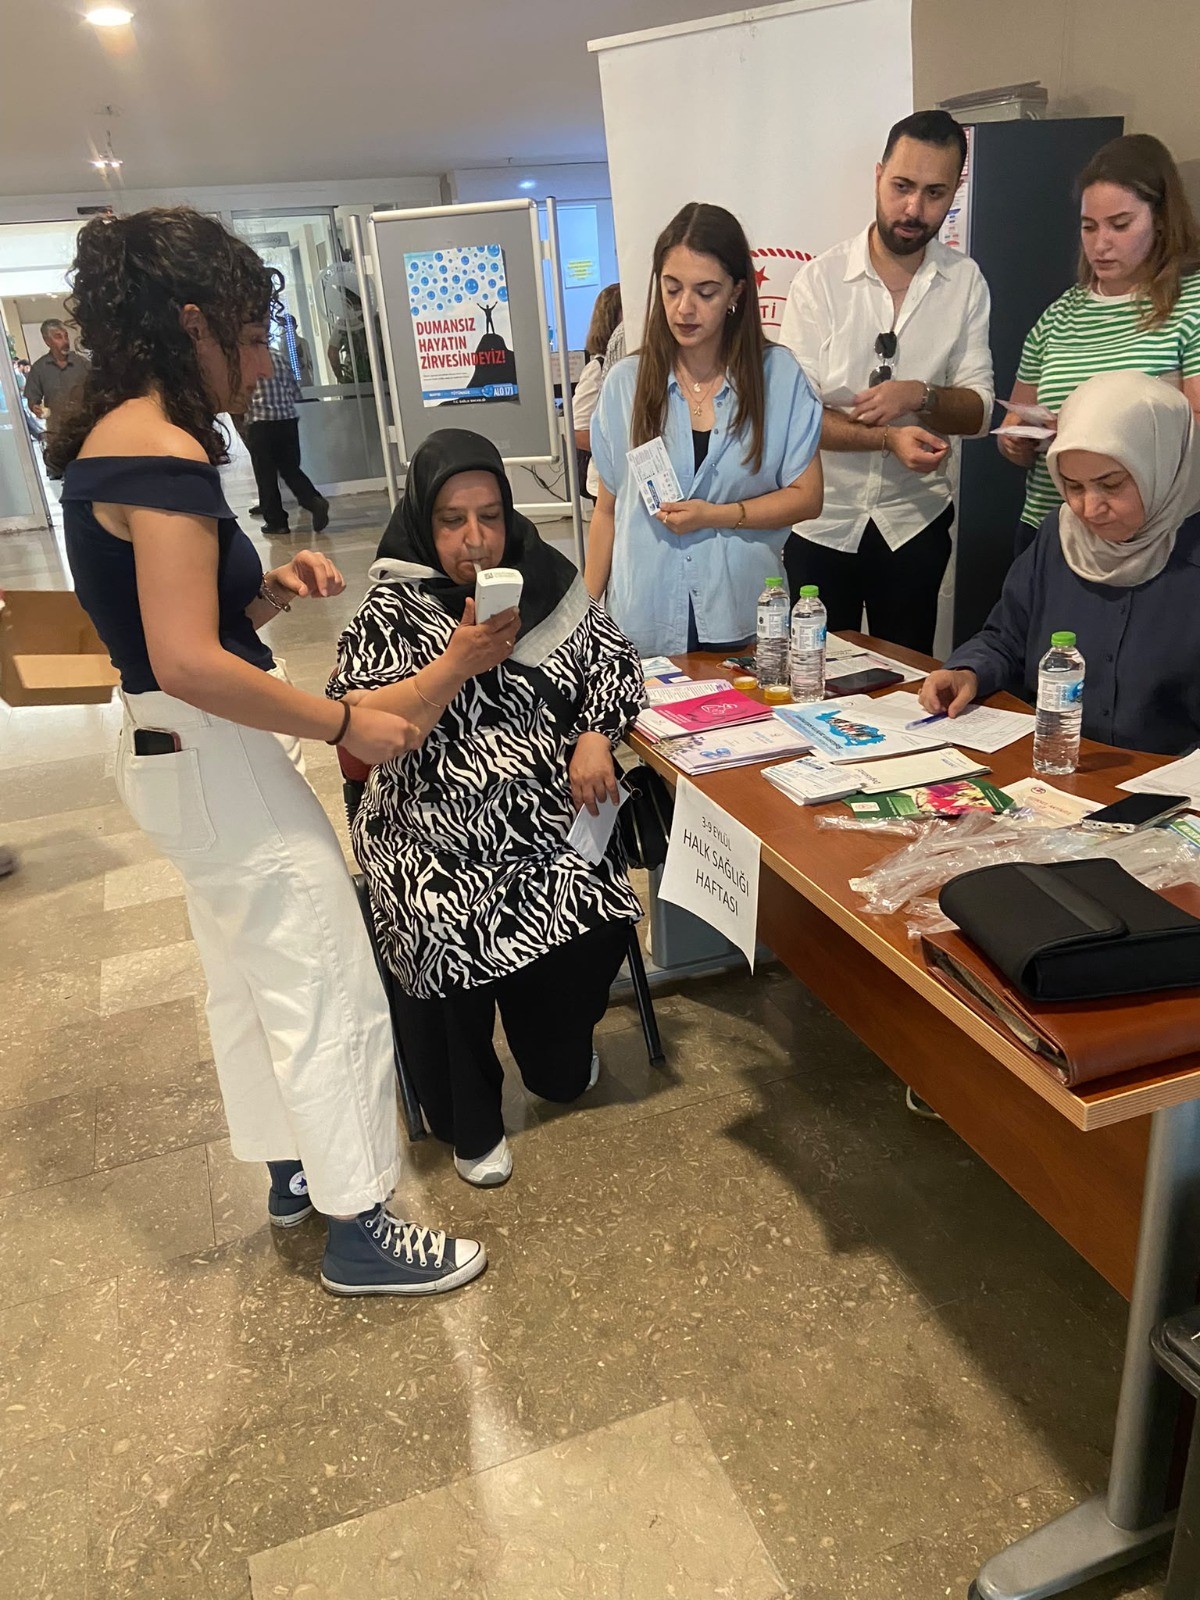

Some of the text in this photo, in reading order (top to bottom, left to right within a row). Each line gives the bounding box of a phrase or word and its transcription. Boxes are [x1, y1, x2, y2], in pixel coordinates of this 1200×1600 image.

[416, 318, 476, 335] DUMANSIZ
[418, 336, 467, 352] HAYATIN
[420, 348, 506, 369] ZİRVESİNDEYİZ!
[493, 387, 504, 396] ALO
[701, 816, 732, 851] 3-9 EYLÜL
[683, 829, 749, 897] HALK SAĞLIĞI
[696, 868, 738, 916] HAFTASI
